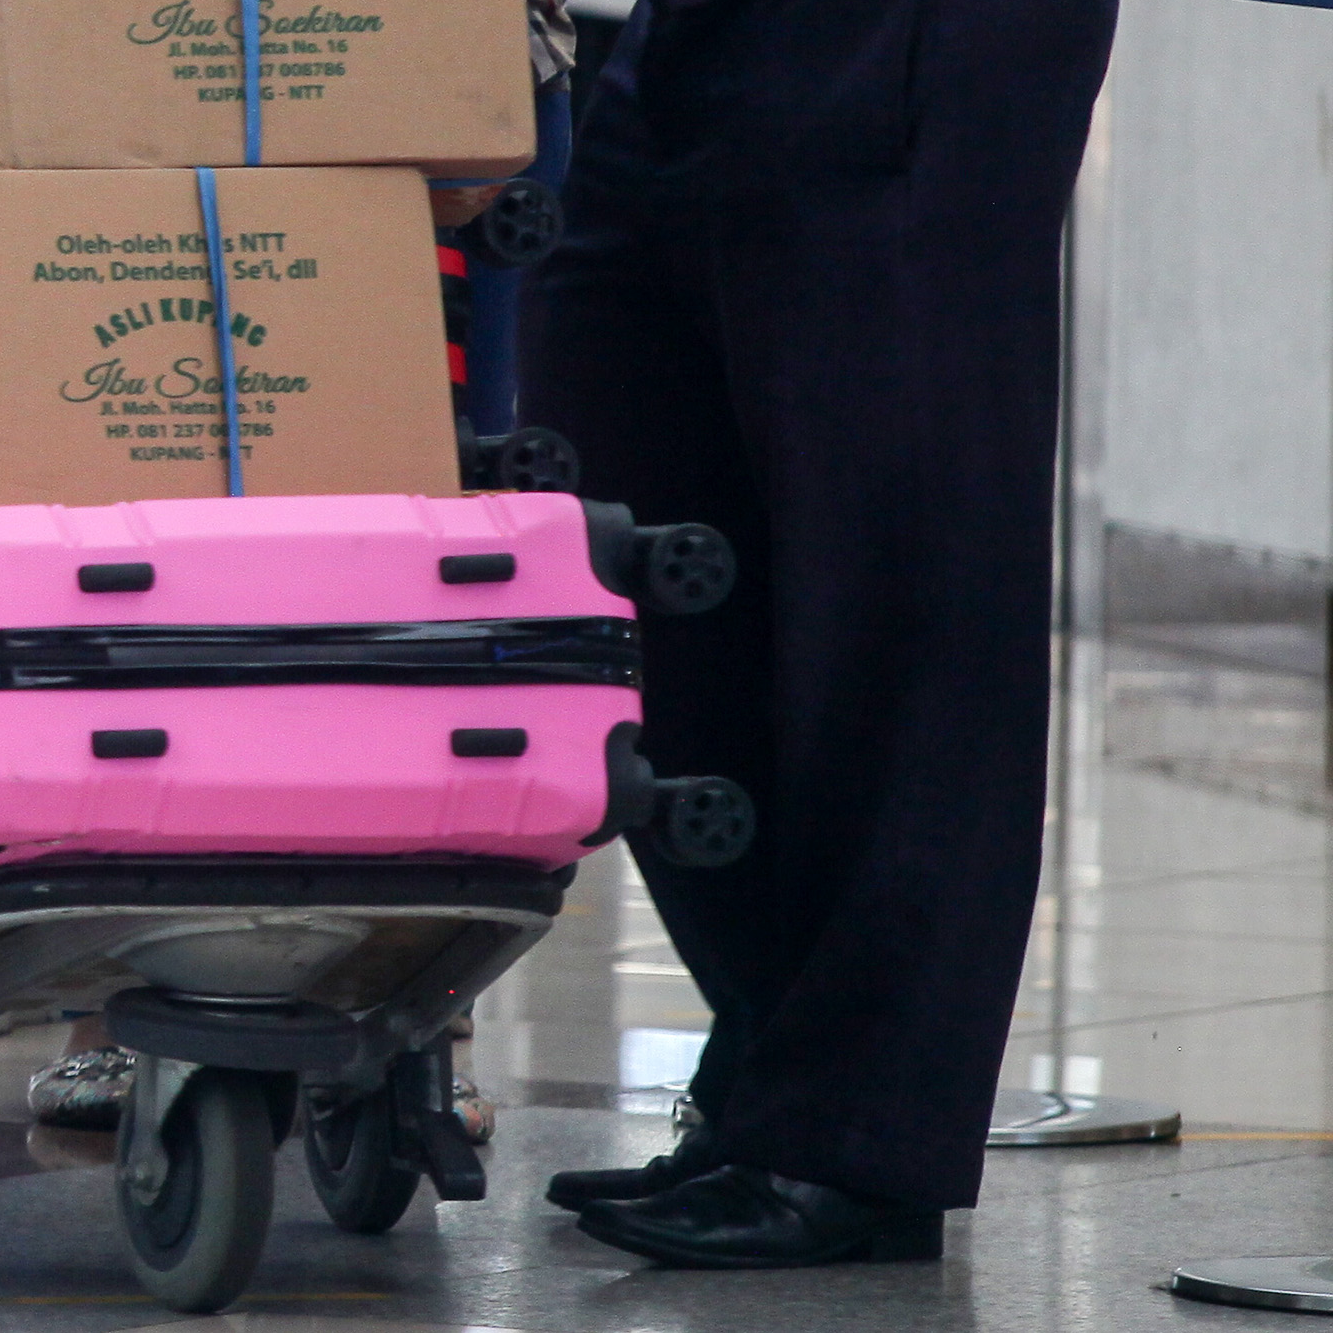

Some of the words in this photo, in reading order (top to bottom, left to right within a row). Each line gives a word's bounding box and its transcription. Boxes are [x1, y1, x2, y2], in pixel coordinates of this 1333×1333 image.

[326, 38, 349, 54] 16
[198, 86, 275, 102] KUPAG
[288, 84, 325, 101] NTT
[56, 234, 172, 255] Oleh-oleh
[178, 233, 234, 253] Khs
[240, 232, 287, 253] NTT
[34, 262, 104, 283] Abon,
[287, 258, 318, 279] dll
[93, 301, 154, 349] ASLI
[159, 297, 268, 348] KUPNG
[59, 357, 149, 403] Ibu
[154, 356, 311, 399] Sokiran
[255, 399, 276, 414] 16
[173, 423, 204, 438] 237
[209, 422, 274, 437] 00786
[129, 446, 205, 461] KUPANG
